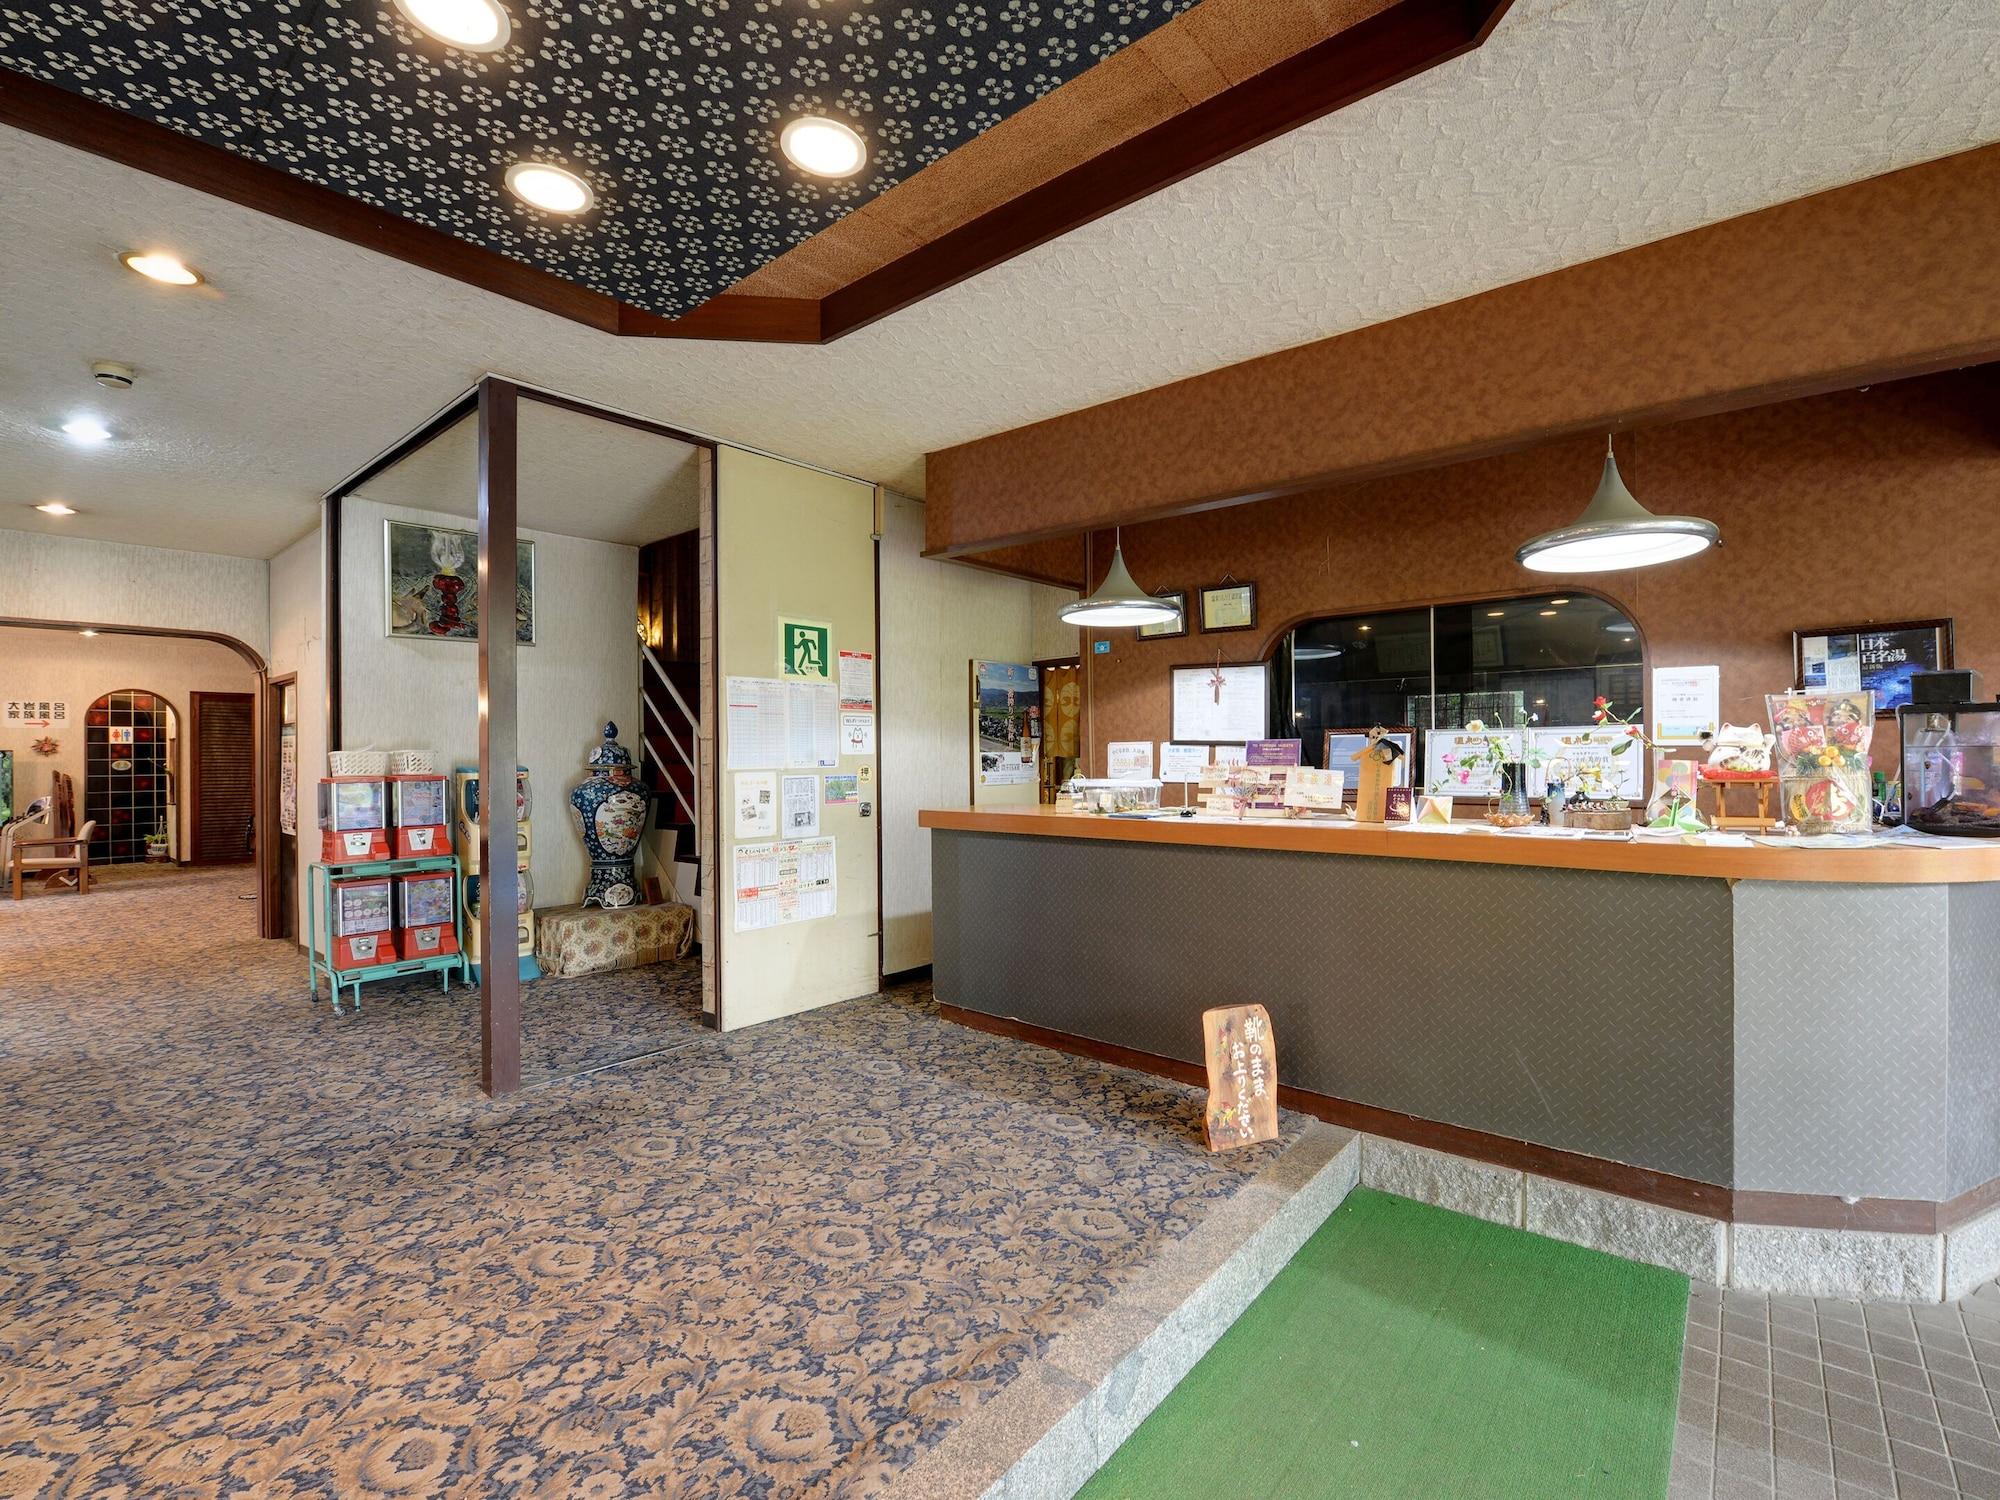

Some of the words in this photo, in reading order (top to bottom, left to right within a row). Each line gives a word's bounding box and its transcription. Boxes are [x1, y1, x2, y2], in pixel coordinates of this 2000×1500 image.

[1861, 637, 1890, 651] 日本
[1861, 649, 1907, 663] 百名湯
[8, 702, 65, 710] 大岩風呂
[8, 711, 65, 719] 家族風呂
